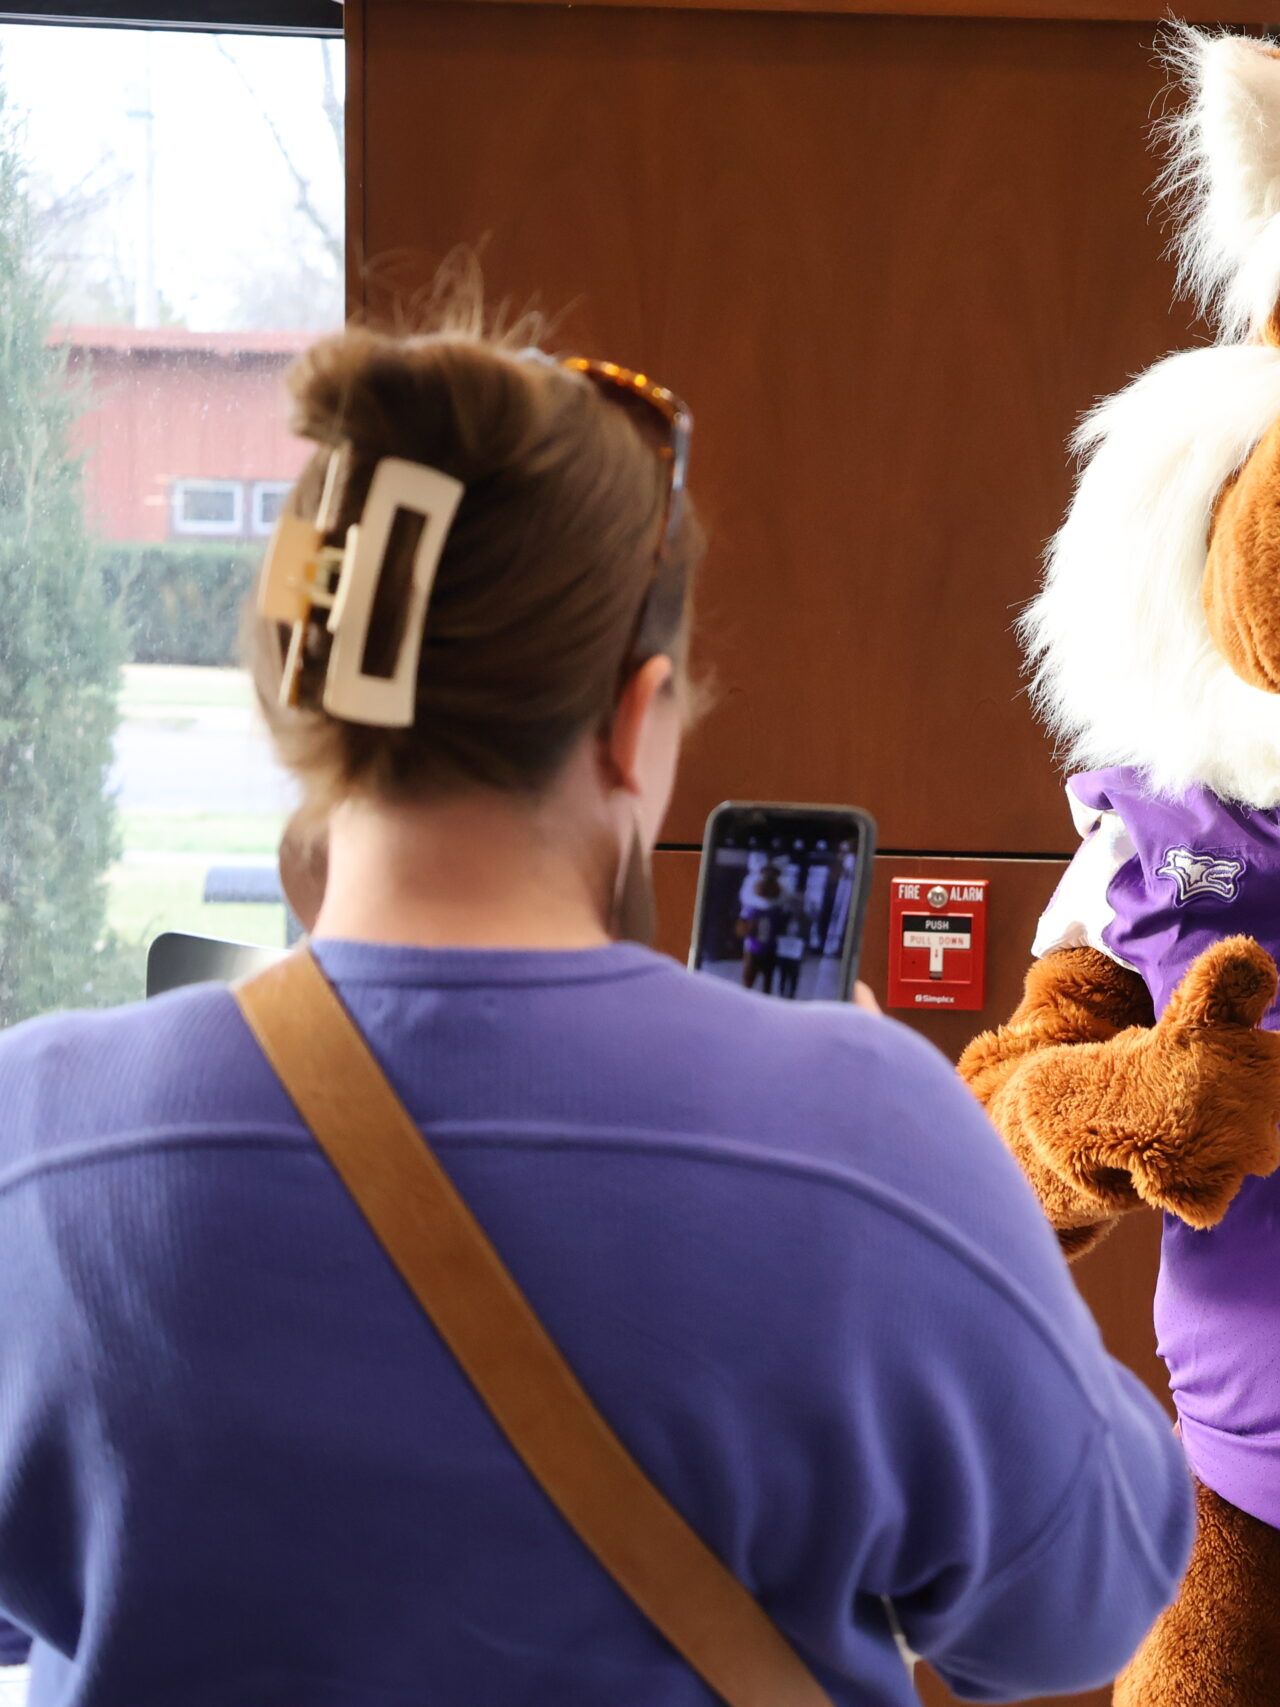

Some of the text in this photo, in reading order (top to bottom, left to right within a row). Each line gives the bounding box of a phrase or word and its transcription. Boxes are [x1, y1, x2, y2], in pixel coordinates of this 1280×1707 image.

[899, 884, 984, 901] FIRE ALARM
[925, 920, 949, 930] PUSH
[910, 935, 964, 945] PULL DOWN
[922, 994, 955, 1004] Simplex
